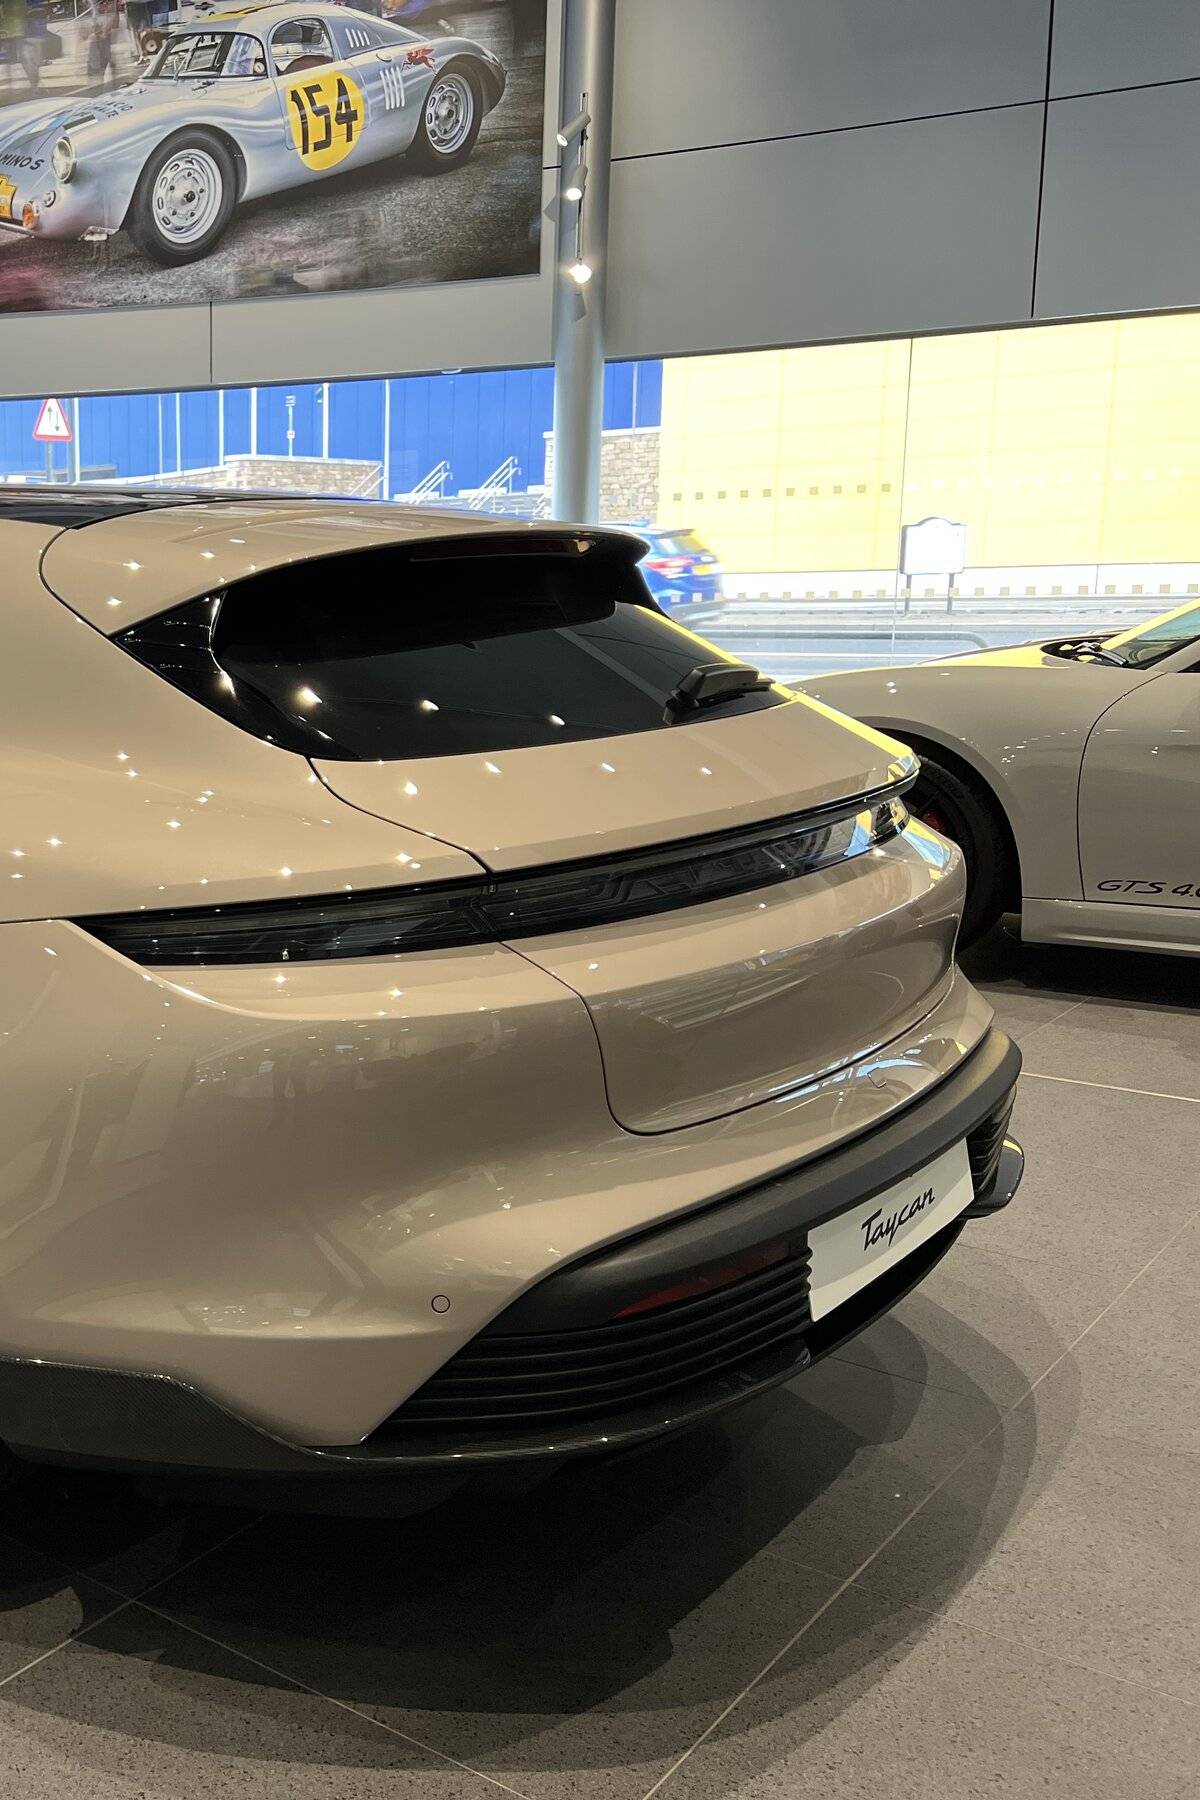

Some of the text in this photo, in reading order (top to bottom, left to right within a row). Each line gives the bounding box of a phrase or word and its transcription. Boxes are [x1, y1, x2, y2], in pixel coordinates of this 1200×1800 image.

[290, 78, 358, 155] 154
[1097, 879, 1168, 894] GTS
[861, 1187, 936, 1251] Taycan
